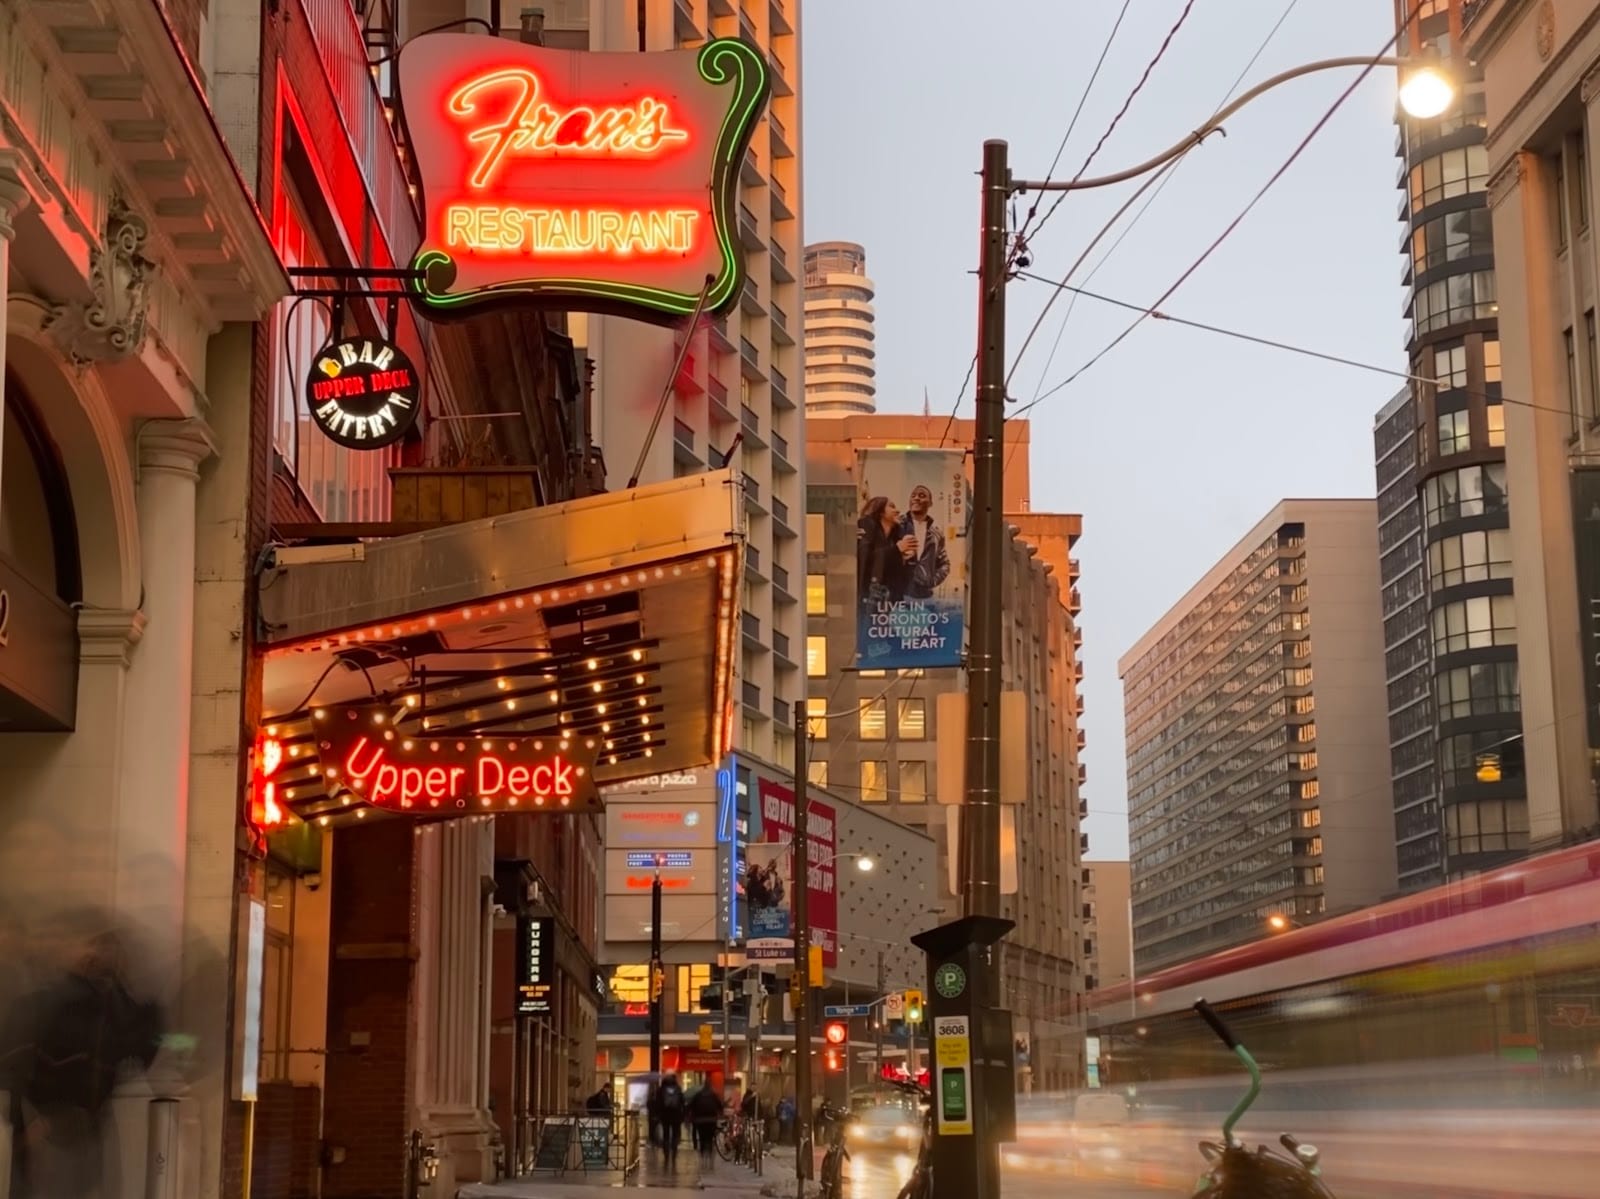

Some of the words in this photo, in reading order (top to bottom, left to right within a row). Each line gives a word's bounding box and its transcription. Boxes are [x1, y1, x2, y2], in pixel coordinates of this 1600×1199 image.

[450, 69, 688, 187] Fran's
[447, 205, 699, 251] RESTAURANT
[338, 341, 394, 371] BAR
[313, 376, 365, 400] UPPER
[370, 369, 411, 392] DECK
[316, 398, 397, 439] EATERY
[877, 601, 907, 613] LIVE
[910, 601, 925, 612] IN
[870, 612, 949, 626] TORONTO'S
[868, 626, 938, 638] CULTURAL
[901, 637, 946, 650] HEART
[346, 737, 465, 807] Upper
[478, 756, 573, 795] Deck
[660, 774, 697, 788] pizza
[938, 1025, 965, 1036] 3608
